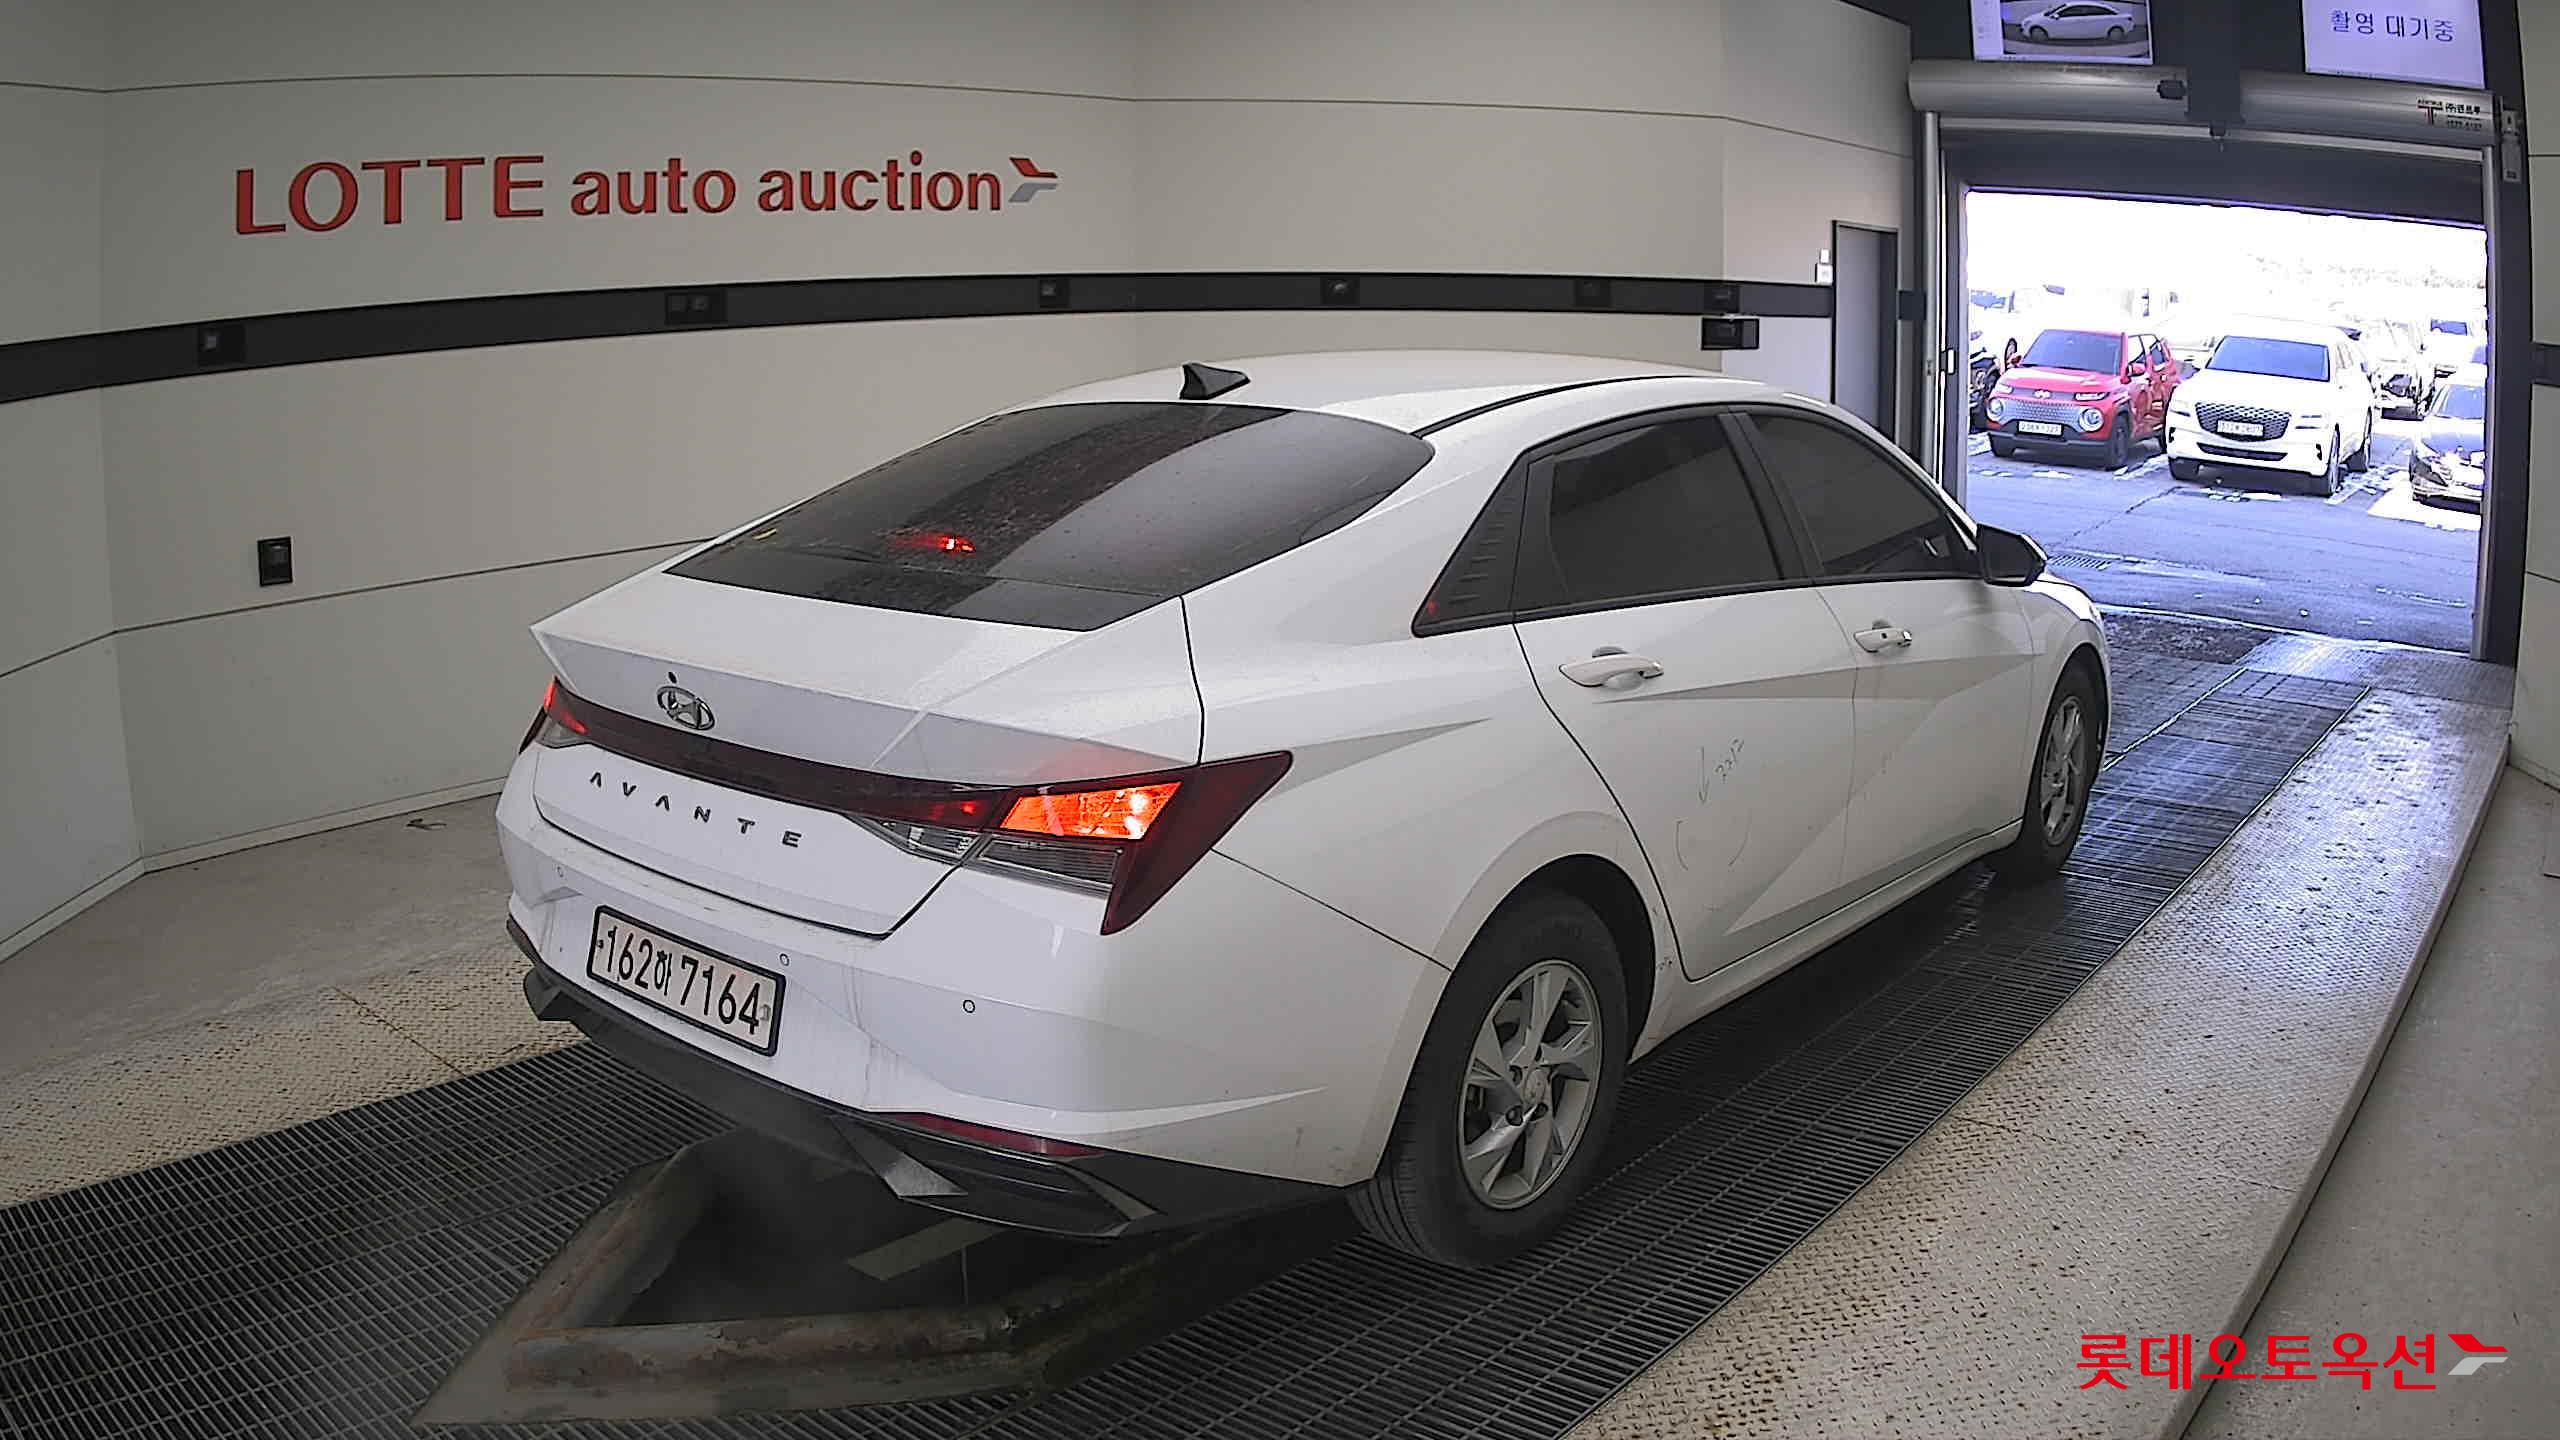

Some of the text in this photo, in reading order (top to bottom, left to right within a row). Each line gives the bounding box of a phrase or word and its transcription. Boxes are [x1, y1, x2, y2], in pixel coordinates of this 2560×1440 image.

[2330, 9, 2454, 42] 촬영 대기중
[236, 150, 1002, 235] LOTTE auto auction
[589, 770, 805, 848] AVANTE
[607, 925, 760, 1035] 162하 7164
